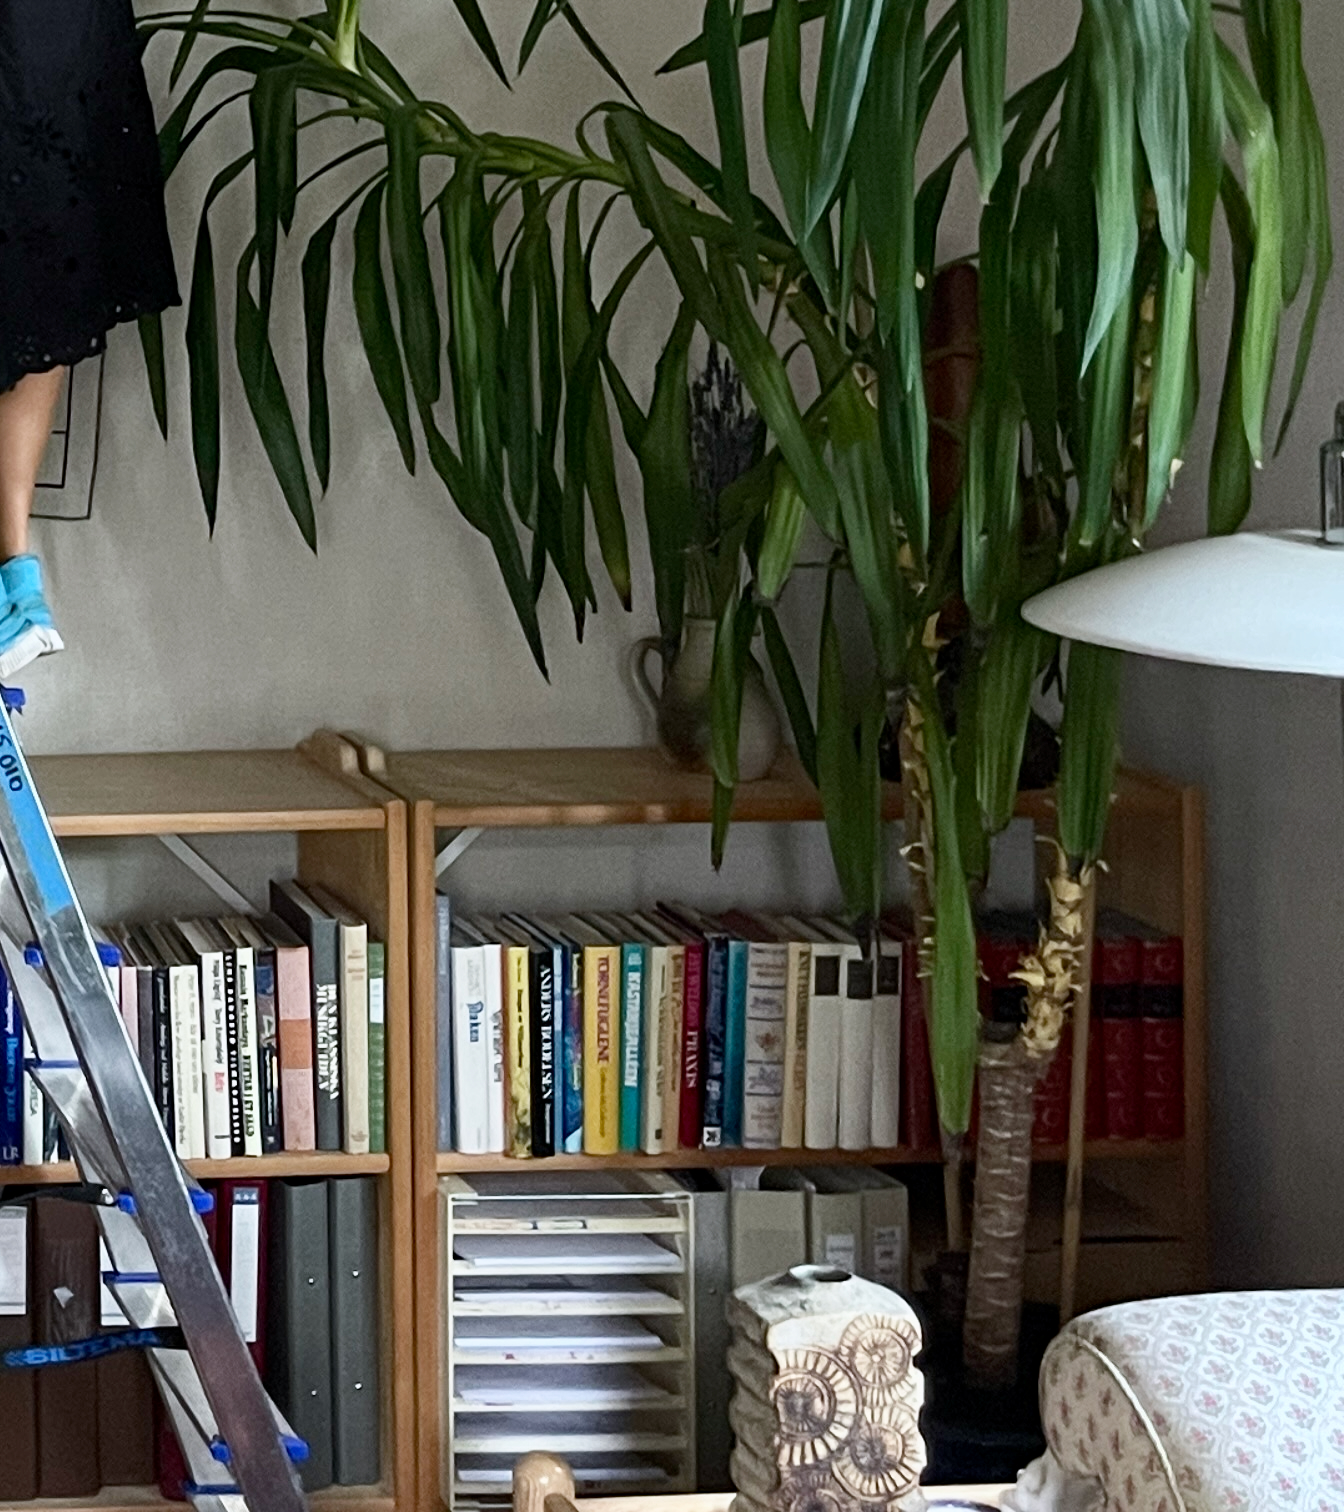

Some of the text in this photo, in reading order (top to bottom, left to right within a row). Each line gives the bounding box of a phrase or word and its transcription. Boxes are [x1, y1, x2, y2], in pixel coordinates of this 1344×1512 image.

[539, 965, 554, 1022] ANDERS
[540, 1025, 553, 1100] BODELSEN
[686, 1029, 699, 1089] PRAXIS
[26, 1329, 161, 1366] BILTEMA
